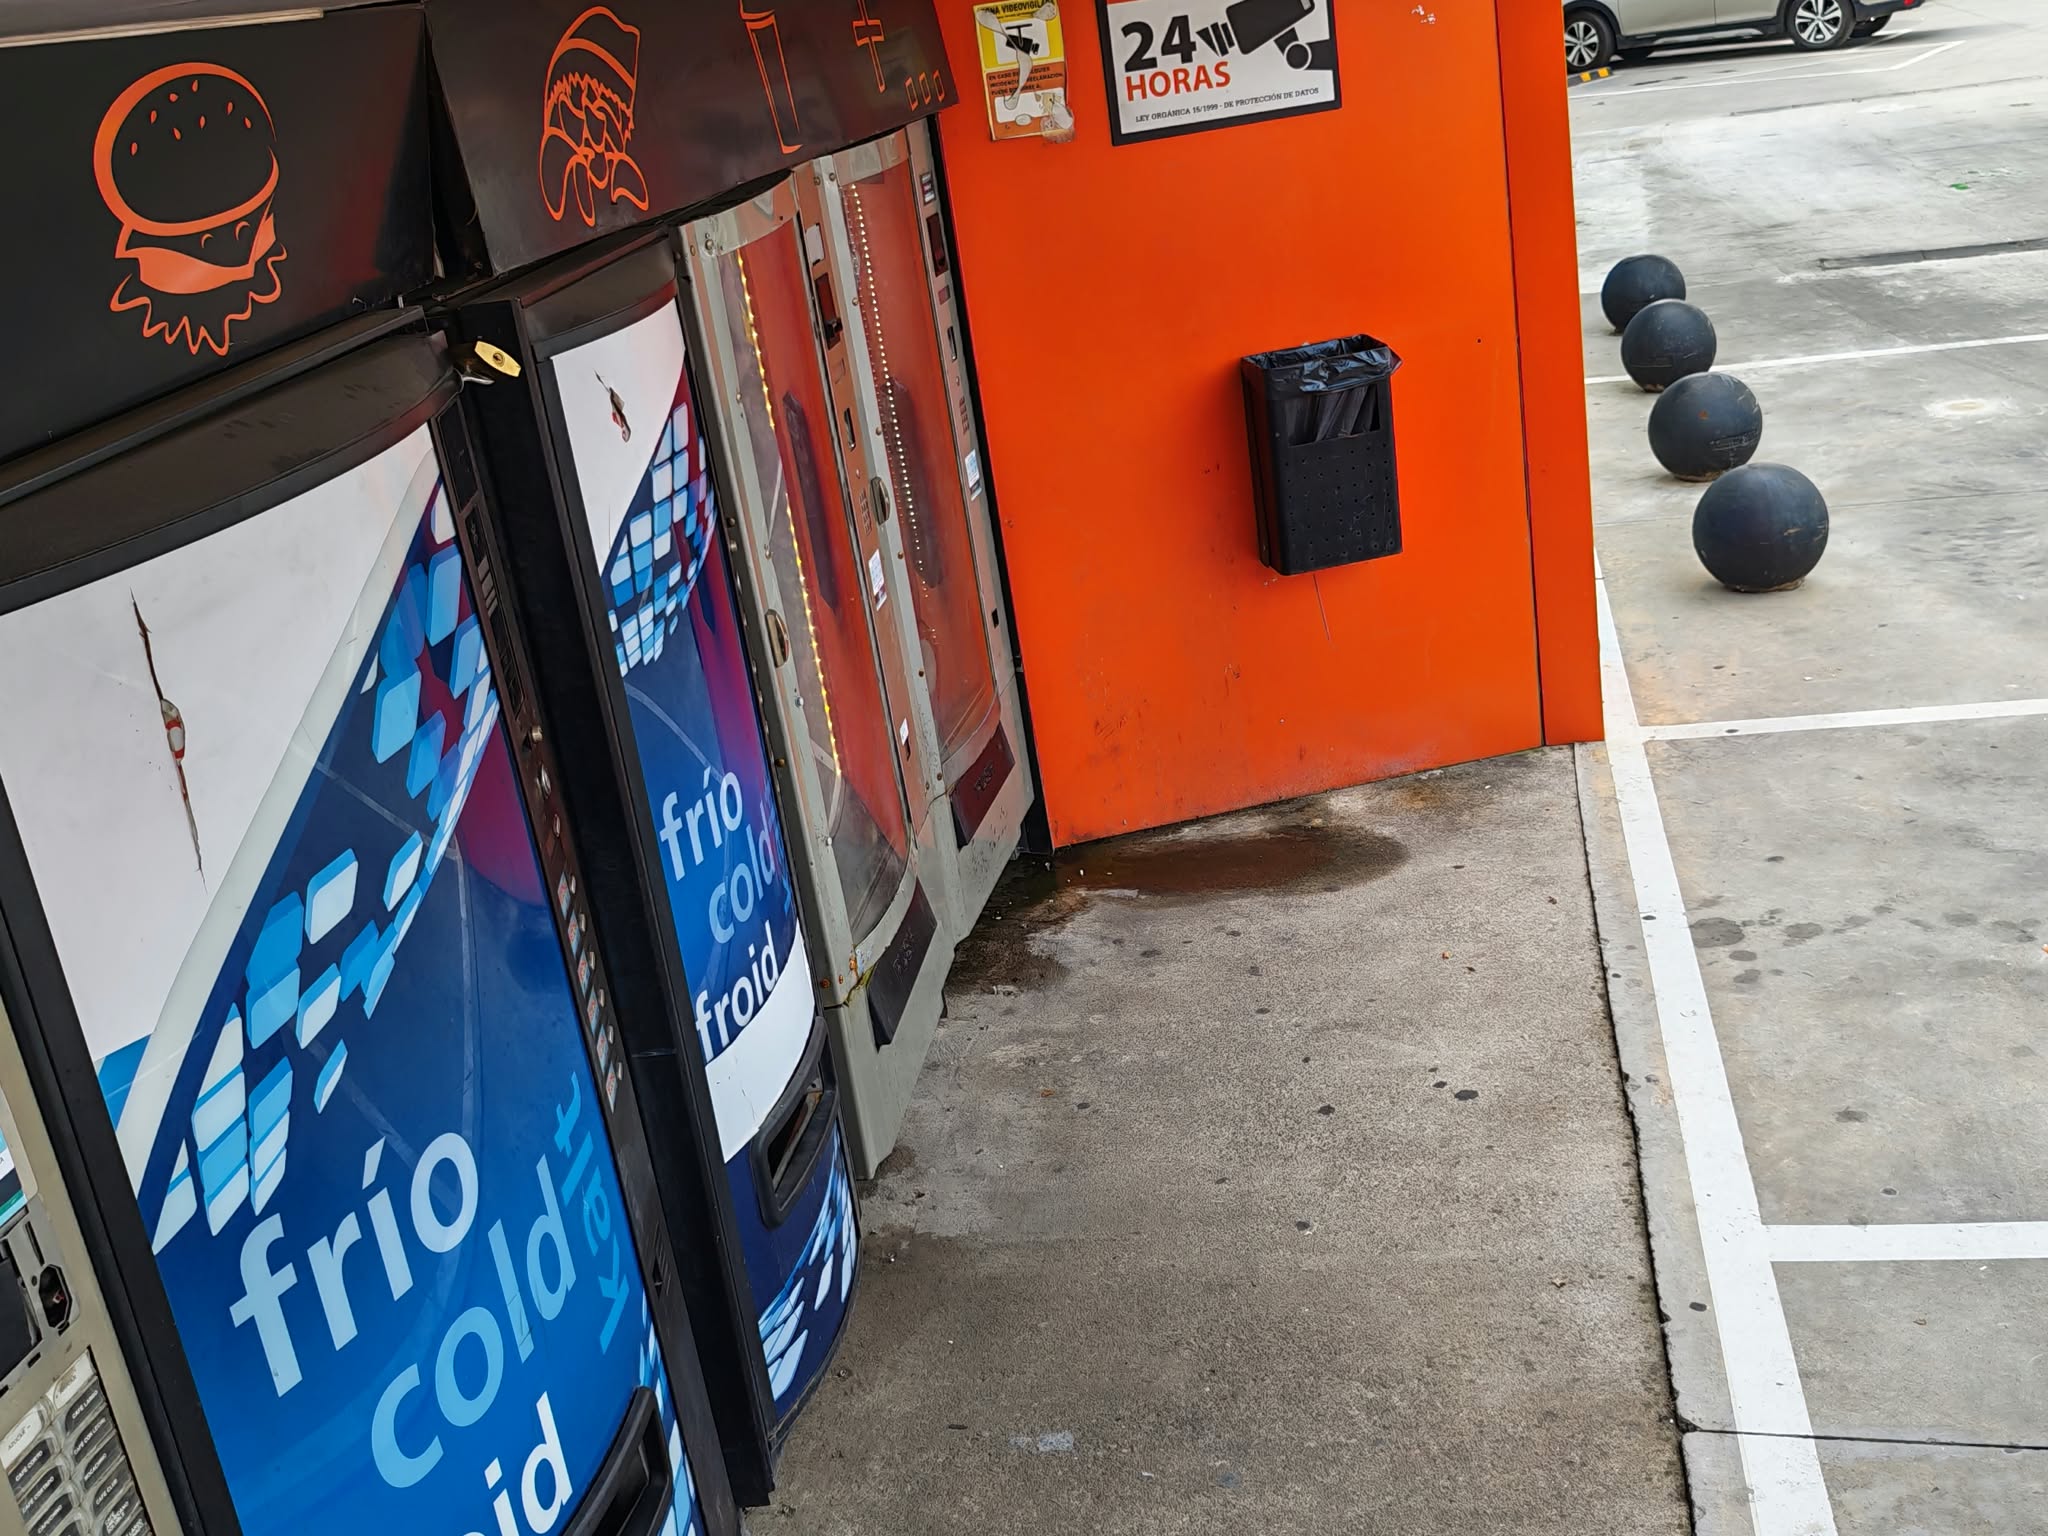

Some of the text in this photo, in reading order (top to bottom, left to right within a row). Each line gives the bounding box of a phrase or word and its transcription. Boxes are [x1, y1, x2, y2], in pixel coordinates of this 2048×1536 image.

[1121, 14, 1197, 73] 24
[1125, 61, 1231, 102] HORAS
[1135, 114, 1150, 122] LEY
[1151, 108, 1191, 120] ORGÁNICA
[1192, 104, 1219, 114] 15/1999
[1223, 101, 1234, 109] DE
[1235, 93, 1282, 107] PROTECCIÓN
[1283, 91, 1294, 99] DE
[1295, 87, 1319, 97] DATOS
[660, 765, 743, 882] frío
[708, 800, 776, 944] cold
[695, 920, 780, 1062] froid
[229, 1132, 479, 1398] frío
[553, 1071, 630, 1355] kalt
[371, 1153, 577, 1488] cold
